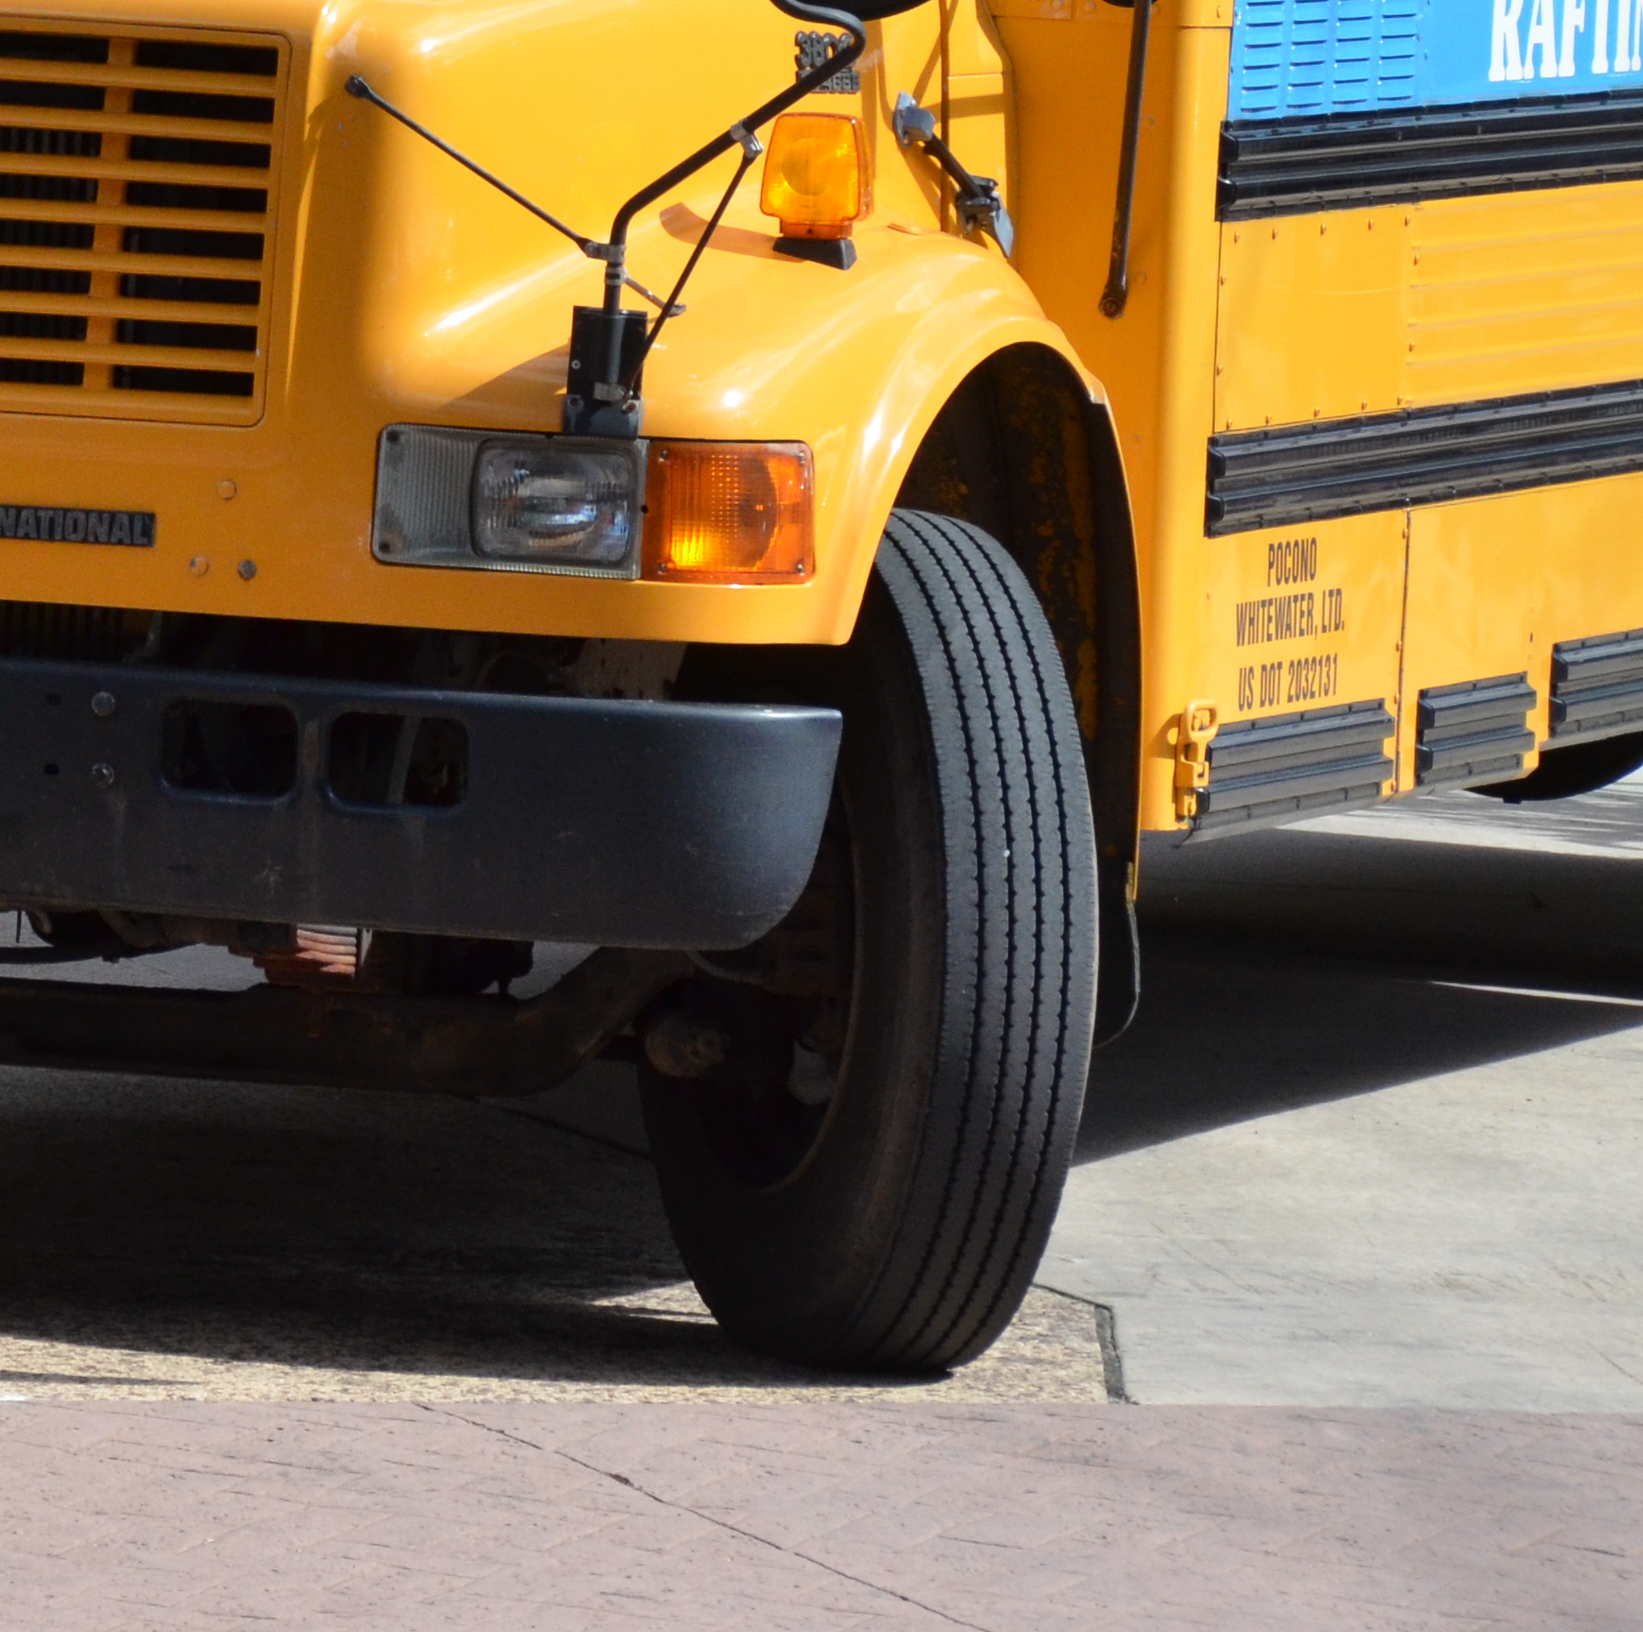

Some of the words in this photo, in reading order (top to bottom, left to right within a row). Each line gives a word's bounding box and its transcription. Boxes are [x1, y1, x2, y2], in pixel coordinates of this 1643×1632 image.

[1267, 537, 1318, 588] POCONO
[1236, 592, 1319, 648] WHITEWATER,
[1321, 587, 1345, 635] LTD.
[1238, 665, 1255, 712] US
[1259, 661, 1284, 709] DOT
[1287, 652, 1339, 704] 2032131
